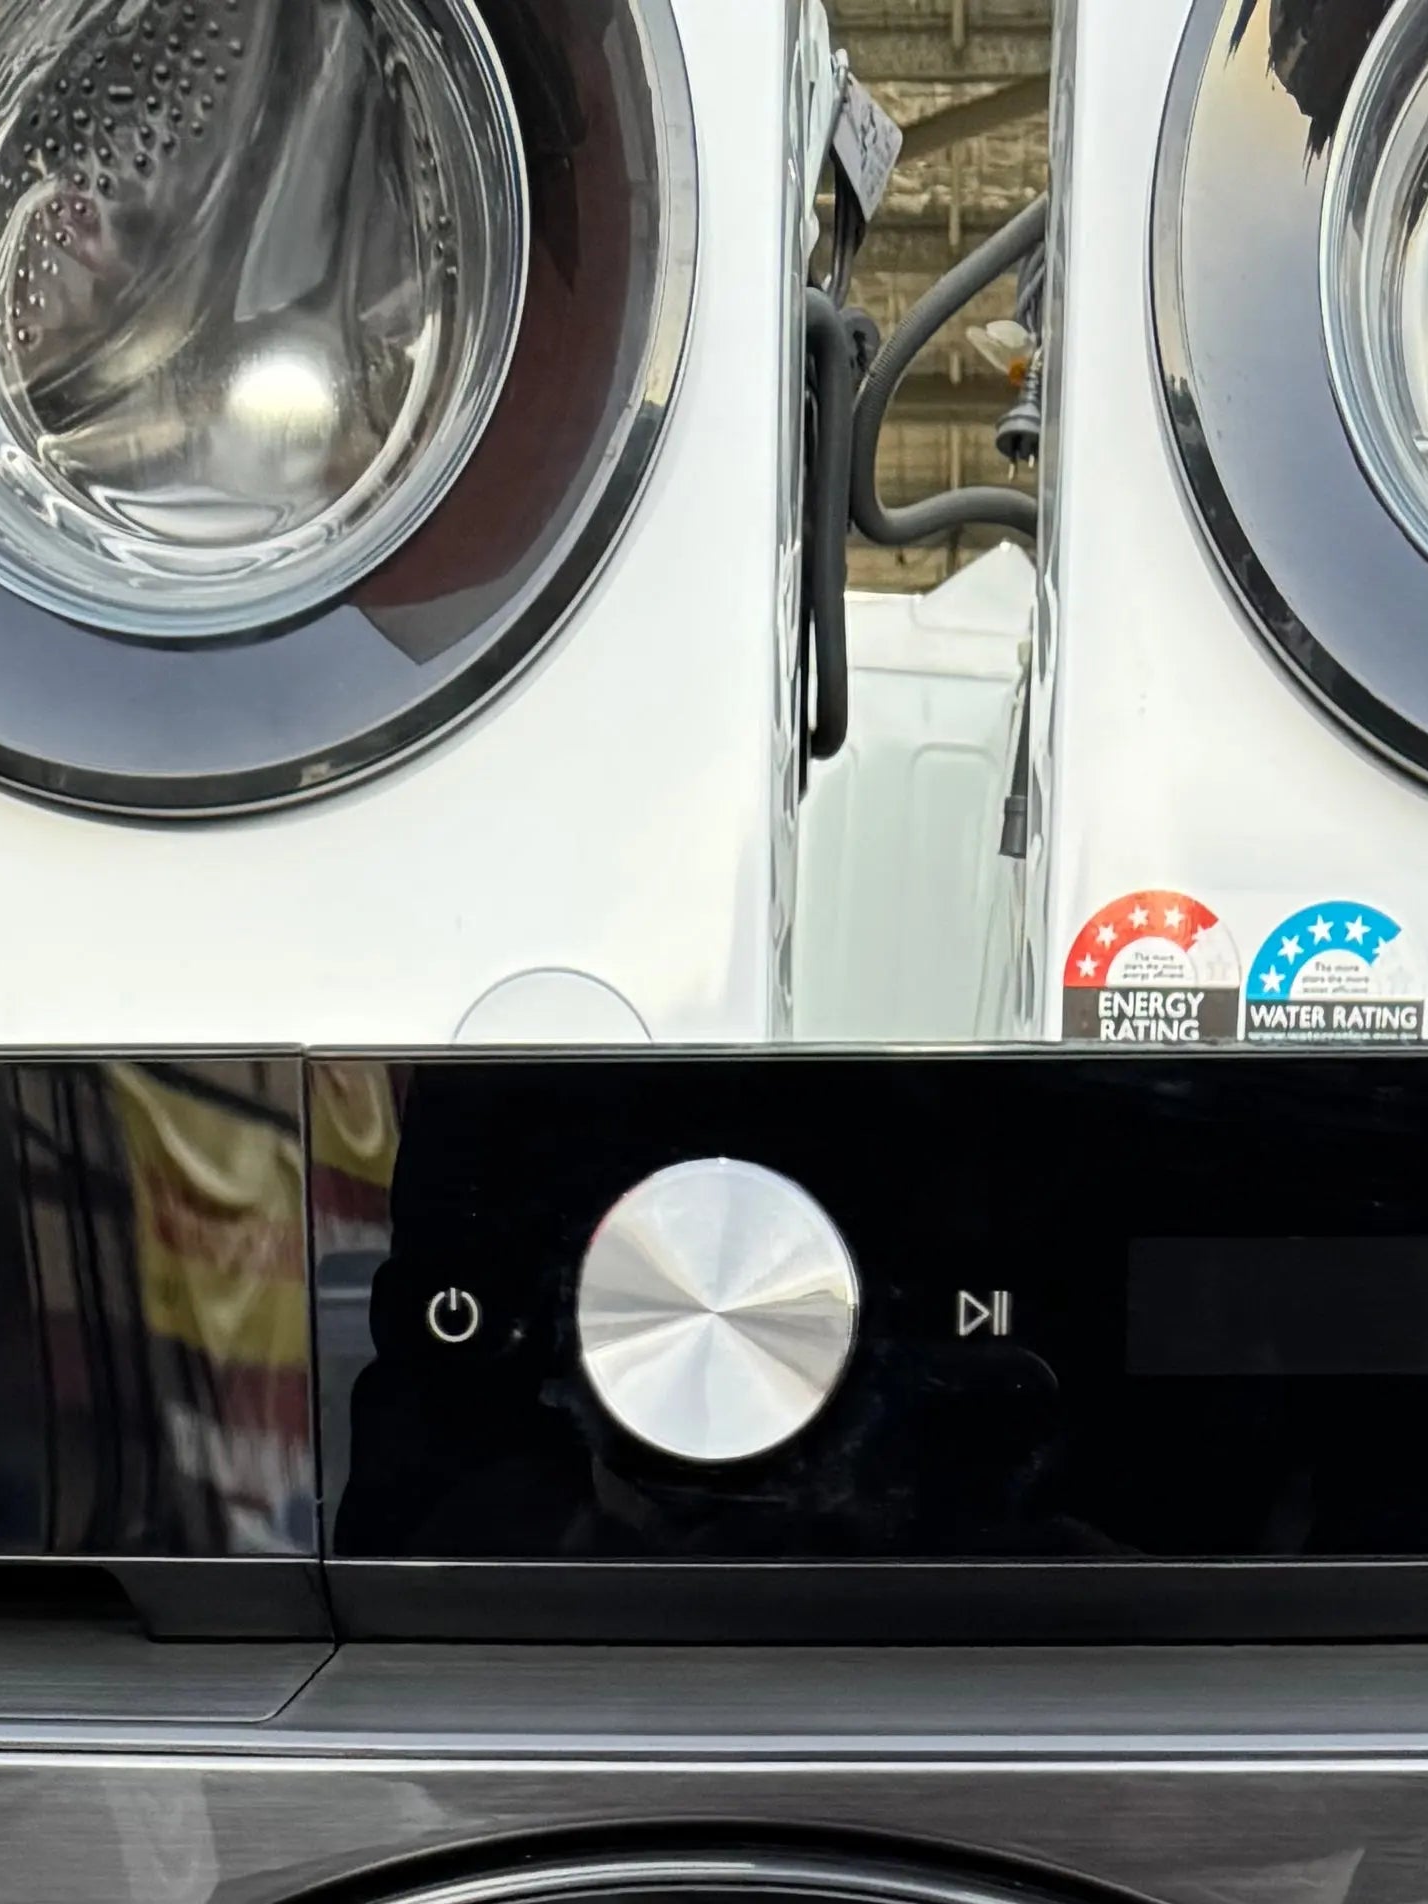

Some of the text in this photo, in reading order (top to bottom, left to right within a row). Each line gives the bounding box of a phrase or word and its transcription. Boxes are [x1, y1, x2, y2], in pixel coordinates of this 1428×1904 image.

[1099, 990, 1204, 1018] ENERGY
[1100, 1019, 1199, 1041] RATING
[1250, 1005, 1417, 1030] WATER RATING
